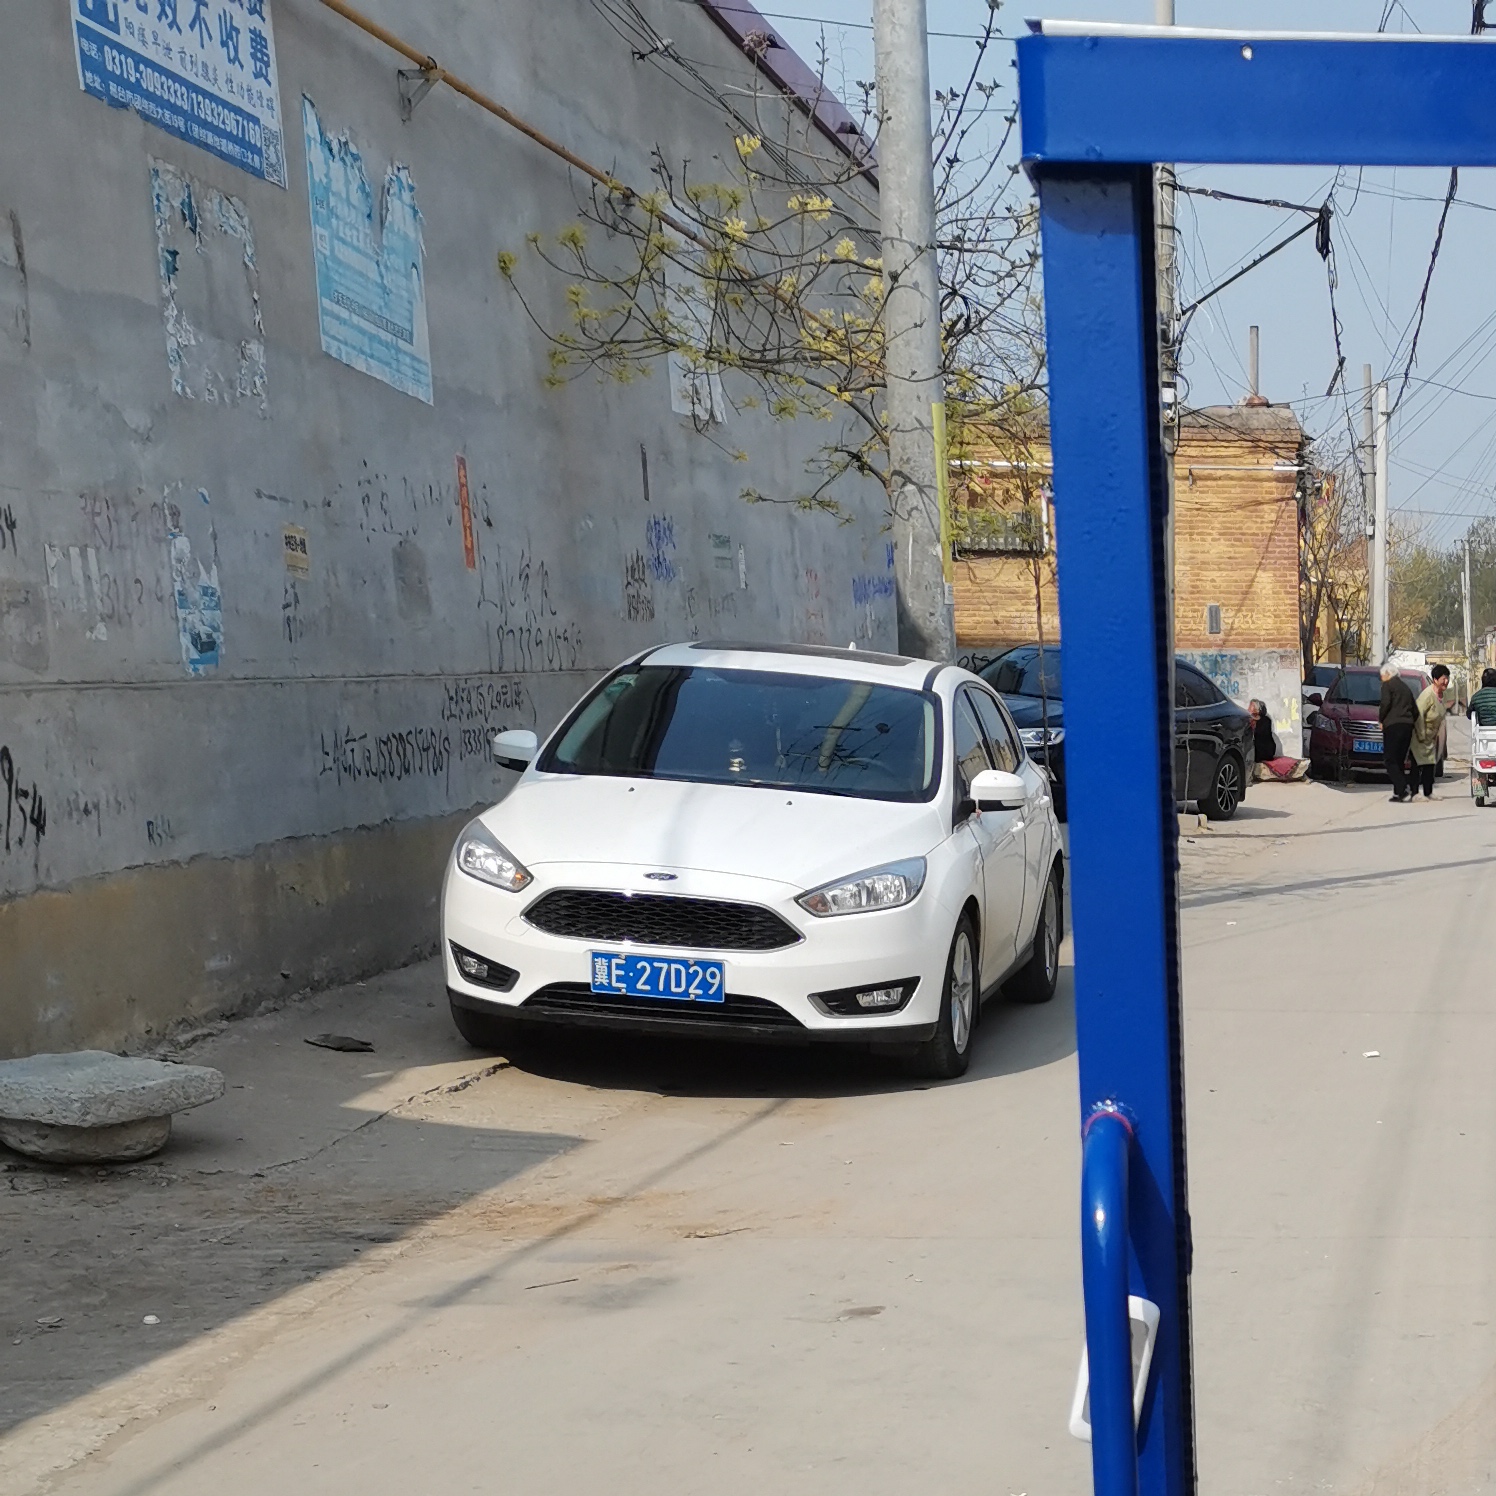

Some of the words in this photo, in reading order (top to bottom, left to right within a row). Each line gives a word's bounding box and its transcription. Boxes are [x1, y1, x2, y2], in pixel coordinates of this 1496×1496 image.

[134, 0, 272, 88] 效不收费
[594, 956, 721, 995] 冀E·27D29
